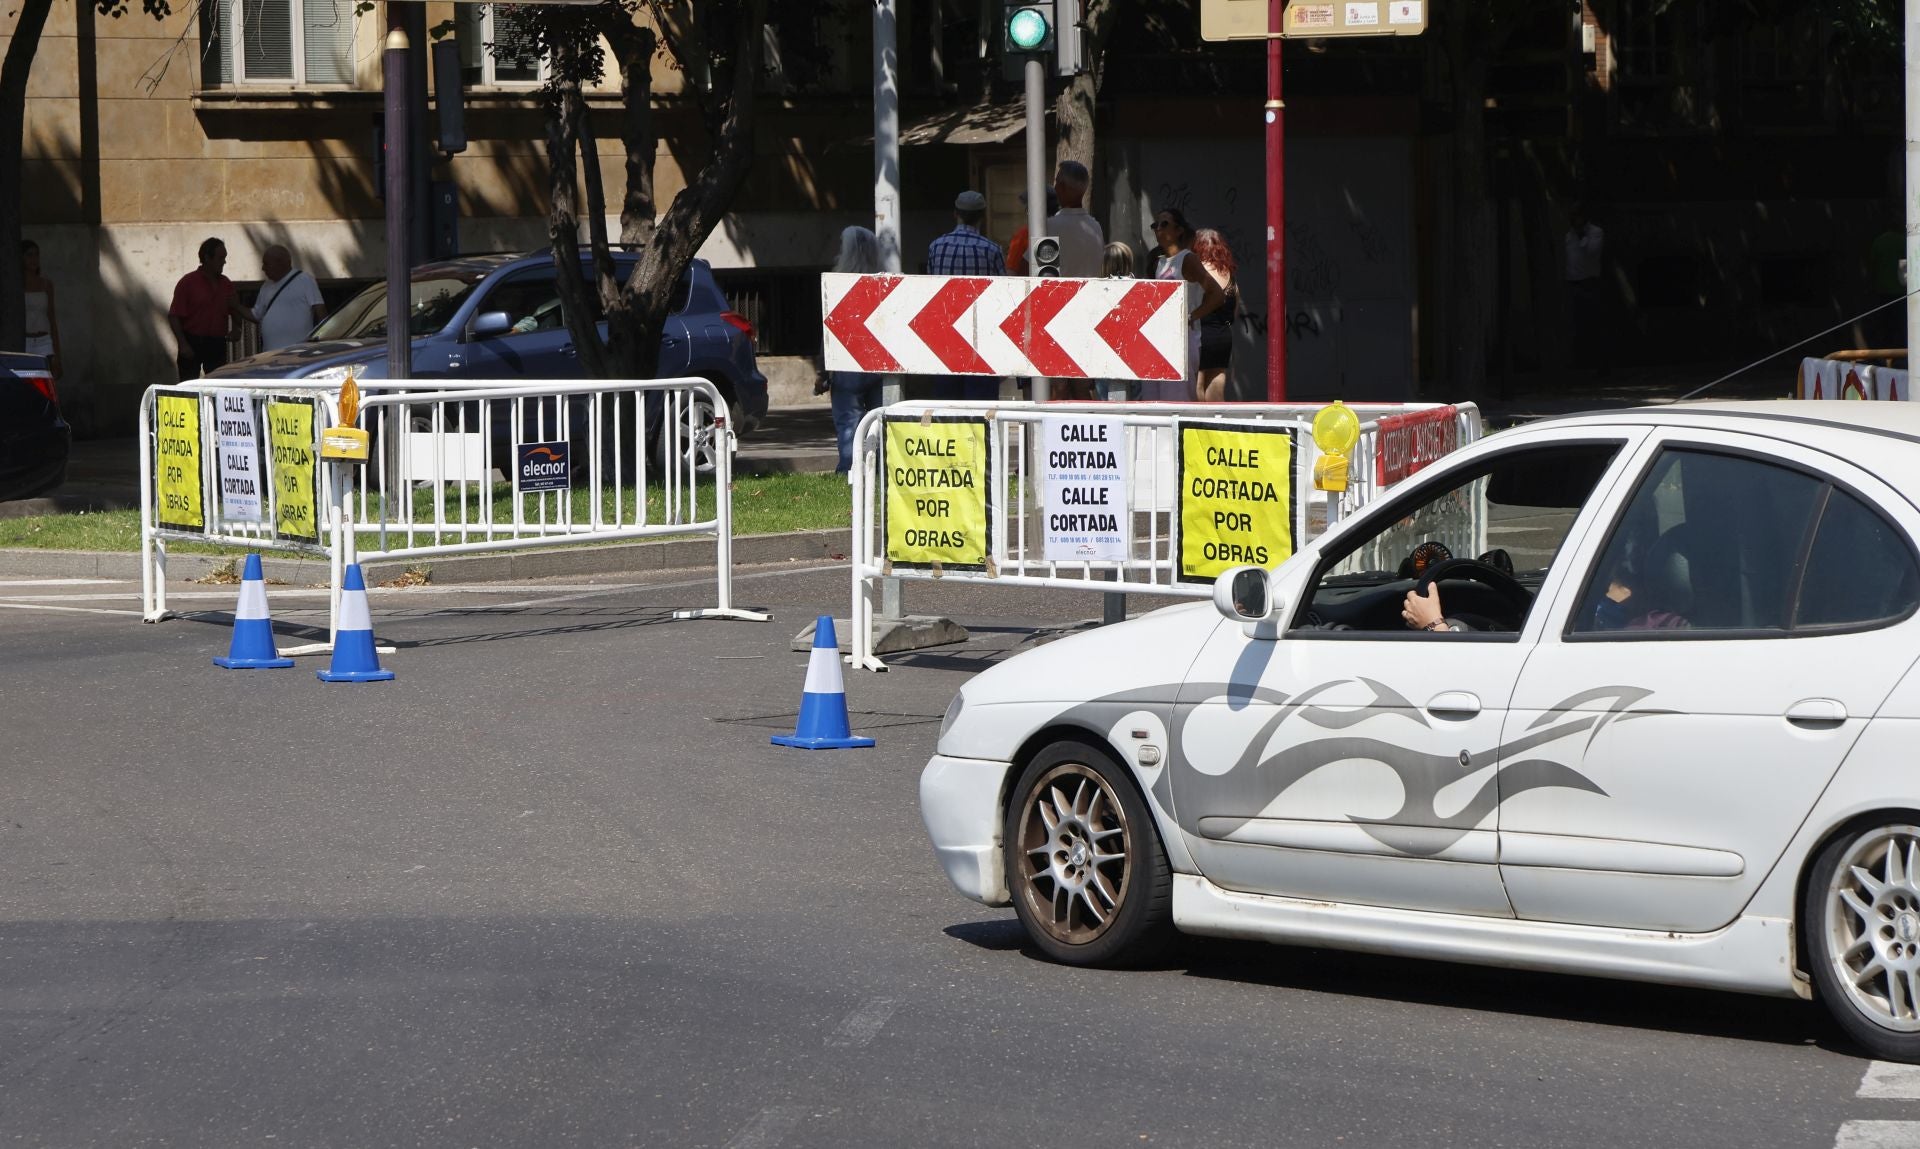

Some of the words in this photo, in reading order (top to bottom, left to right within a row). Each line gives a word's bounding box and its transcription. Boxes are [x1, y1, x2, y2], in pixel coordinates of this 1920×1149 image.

[223, 396, 245, 413] CALLE
[163, 411, 186, 428] CALLE
[220, 420, 252, 437] CORTADA
[275, 417, 299, 436] CALLE
[1061, 424, 1107, 442] CALLE
[905, 438, 956, 456] CALLE
[227, 454, 249, 471] CALLE
[1049, 450, 1117, 469] CORTADA
[1207, 446, 1259, 468] CALLE
[168, 466, 183, 483] POR
[523, 460, 566, 477] elecnor
[895, 467, 974, 488] CORTADA
[224, 478, 255, 495] CORTADA
[1192, 477, 1278, 502] CORTADA
[1062, 487, 1108, 505] CALLE
[916, 499, 949, 518] POR
[1050, 514, 1118, 532] CORTADA
[1214, 511, 1252, 532] POR
[905, 529, 964, 548] OBRAS
[1203, 542, 1269, 565] OBRAS
